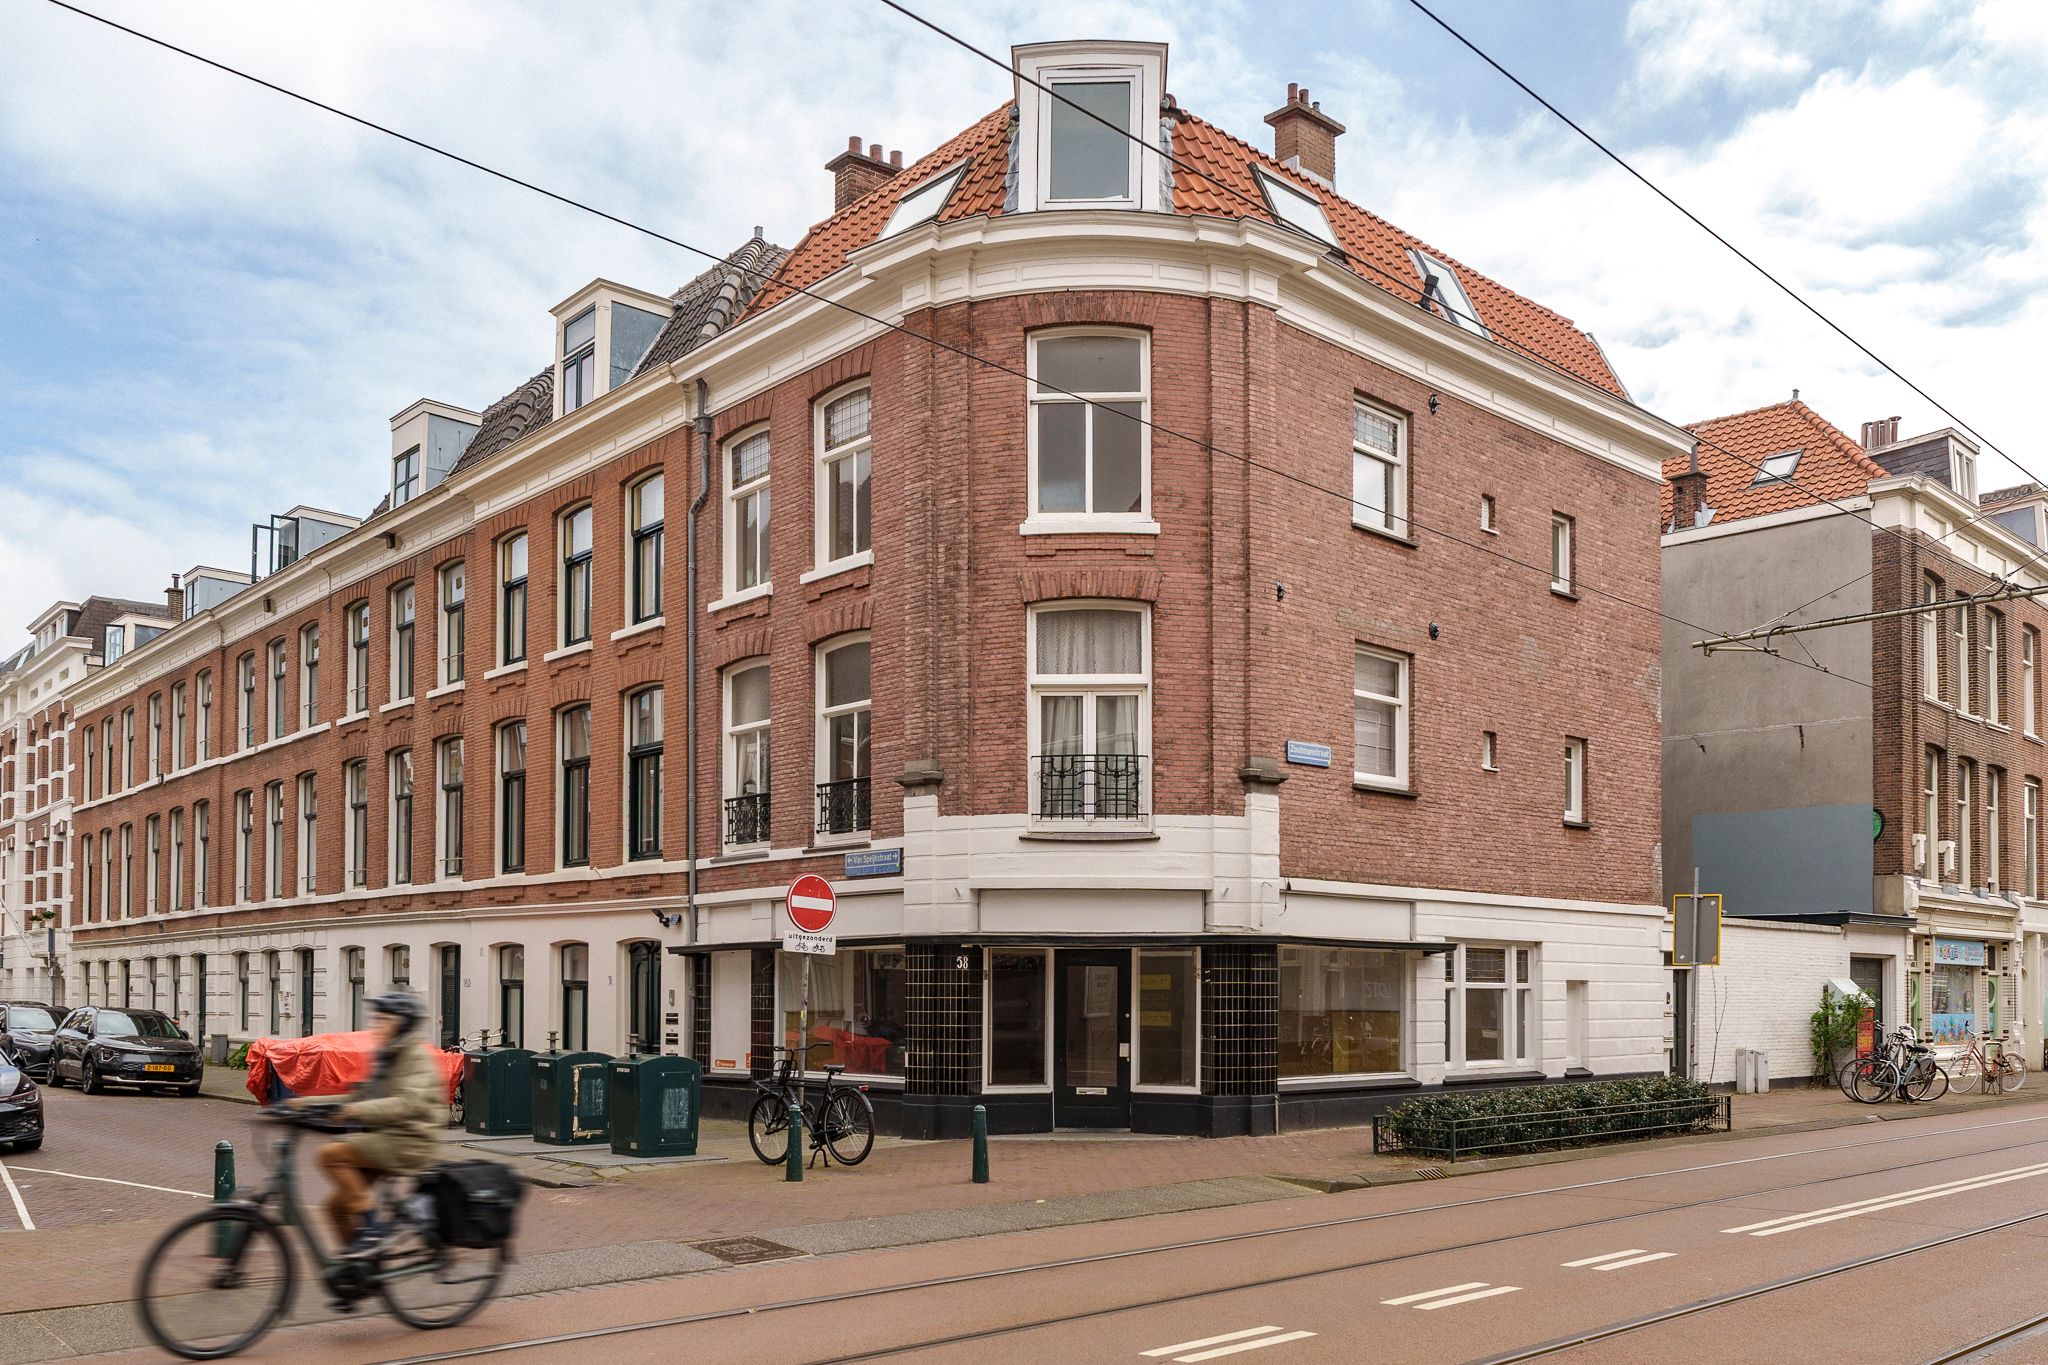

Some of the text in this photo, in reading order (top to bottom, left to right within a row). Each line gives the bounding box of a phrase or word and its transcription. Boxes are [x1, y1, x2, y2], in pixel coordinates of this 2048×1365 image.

[854, 855, 863, 864] Van
[788, 933, 833, 943] uitgezonderd
[956, 955, 969, 970] 58
